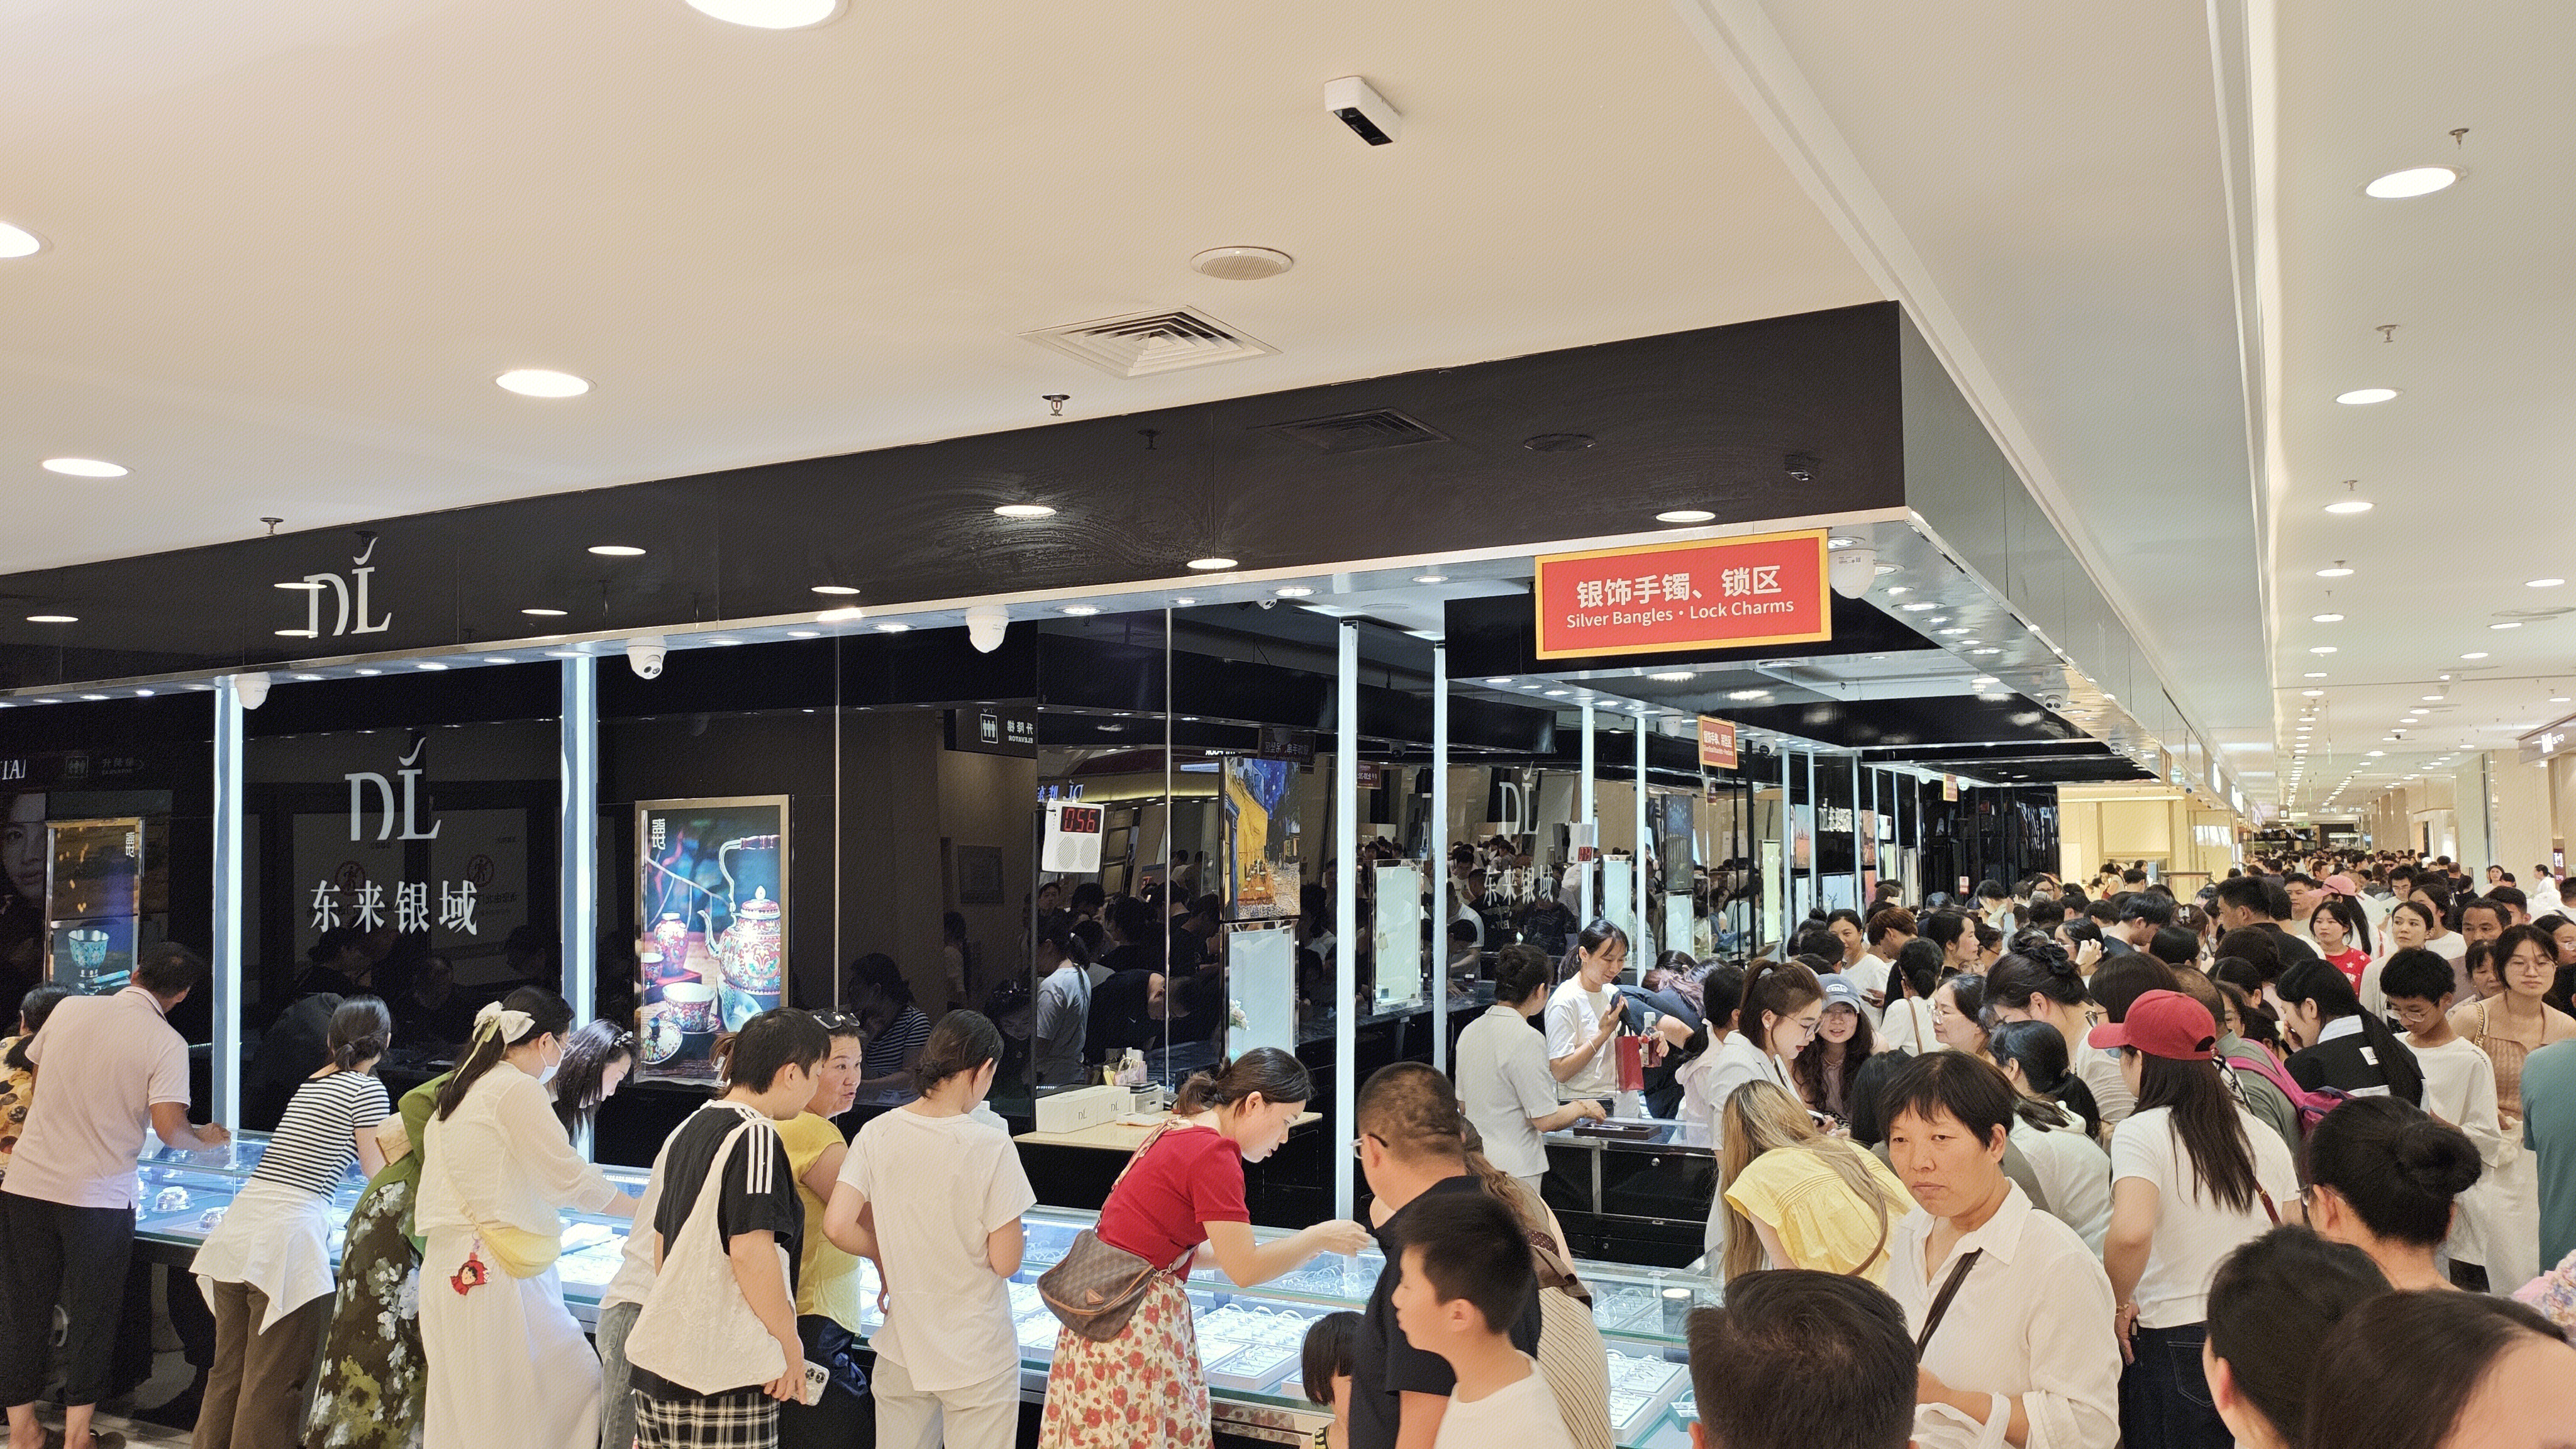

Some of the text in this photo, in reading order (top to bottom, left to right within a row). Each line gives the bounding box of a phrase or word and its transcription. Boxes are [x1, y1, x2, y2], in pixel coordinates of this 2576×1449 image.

[1576, 565, 1782, 609] 银饰手镯、锁区
[1567, 613, 1609, 628] Silver
[1613, 608, 1674, 626] Bangles
[1690, 602, 1728, 619] Lock
[1731, 600, 1794, 616] Charms
[1063, 808, 1096, 833] 056
[1482, 863, 1554, 907] 东来银域
[309, 879, 477, 936] 东来银域
